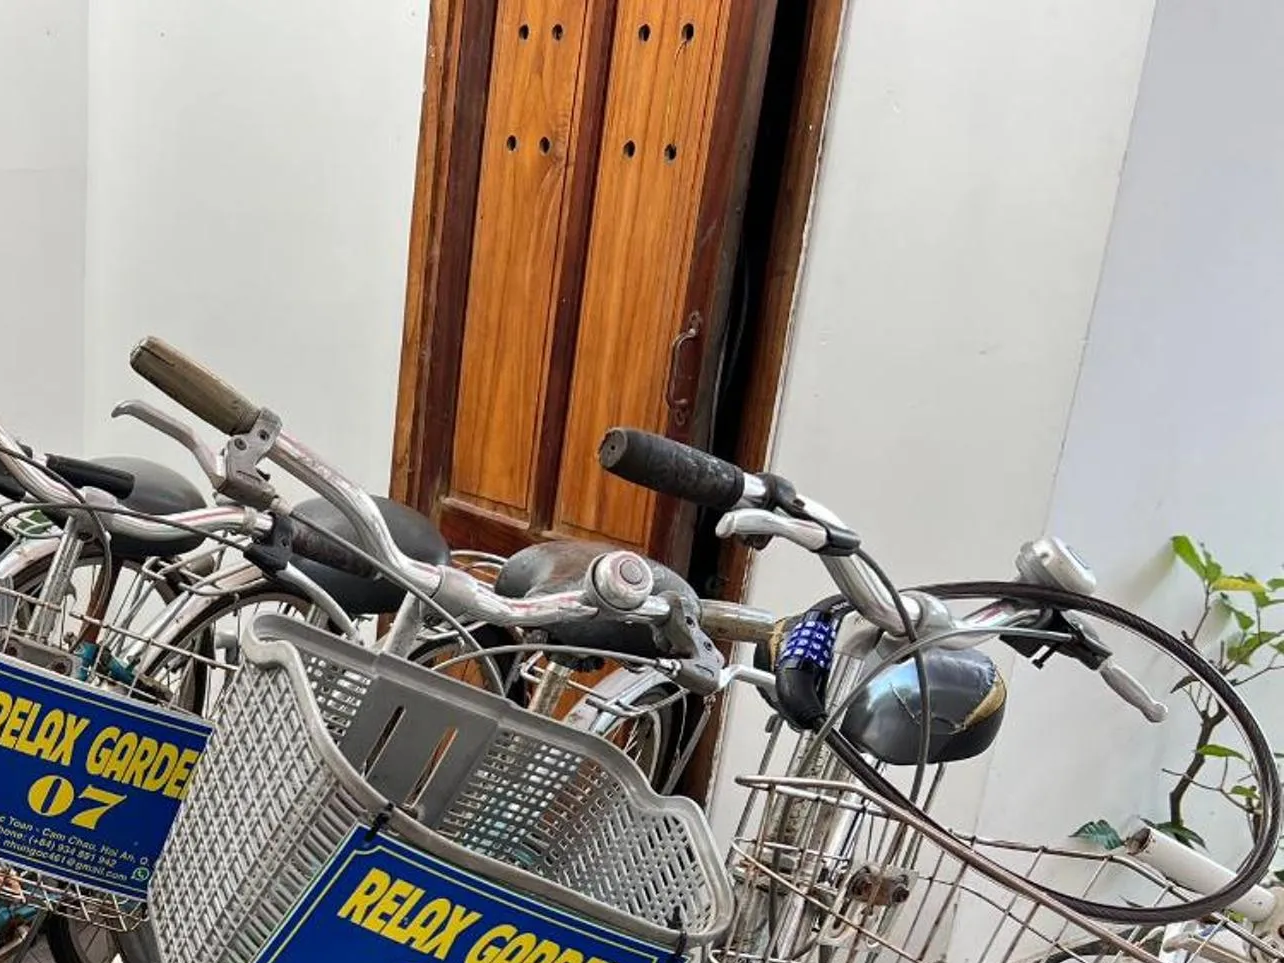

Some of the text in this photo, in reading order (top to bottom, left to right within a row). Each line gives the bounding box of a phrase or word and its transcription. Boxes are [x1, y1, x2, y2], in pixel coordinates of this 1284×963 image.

[86, 726, 203, 800] GARDE
[9, 815, 33, 831] Toan
[27, 774, 127, 830] 07
[337, 867, 482, 960] RELAX
